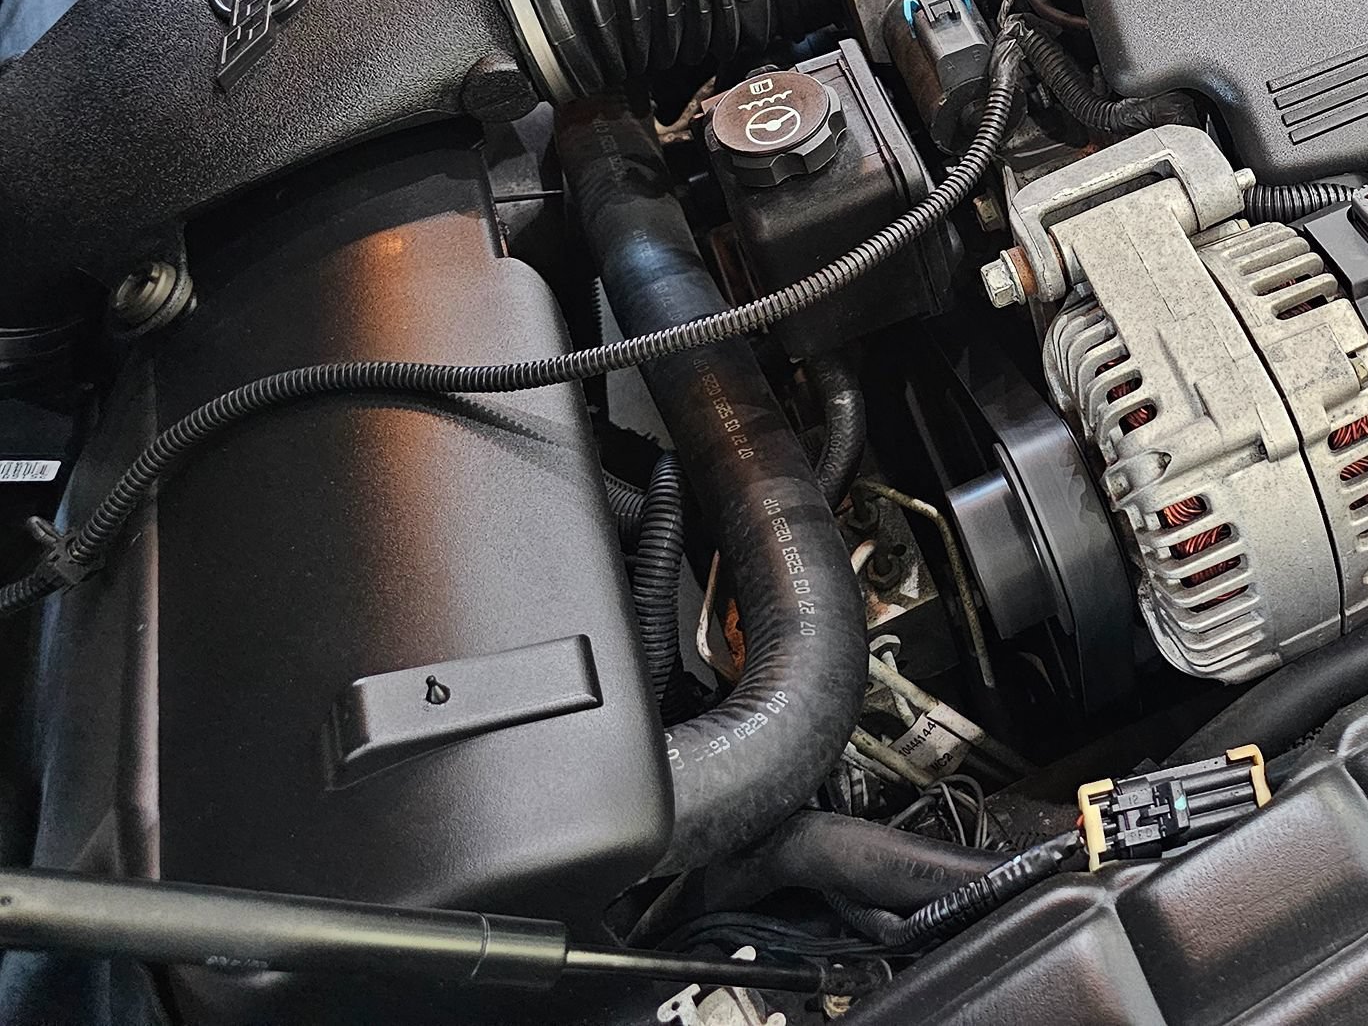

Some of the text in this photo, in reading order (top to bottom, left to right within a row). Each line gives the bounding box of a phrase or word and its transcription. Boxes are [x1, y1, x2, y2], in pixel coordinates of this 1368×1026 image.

[712, 396, 734, 420] 5293
[724, 418, 741, 433] 03
[731, 434, 748, 446] 27
[737, 447, 754, 460] 07
[763, 498, 816, 636] 07 27 03 5293 0229 CIP
[733, 712, 769, 740] 0229
[766, 690, 789, 714] CIP
